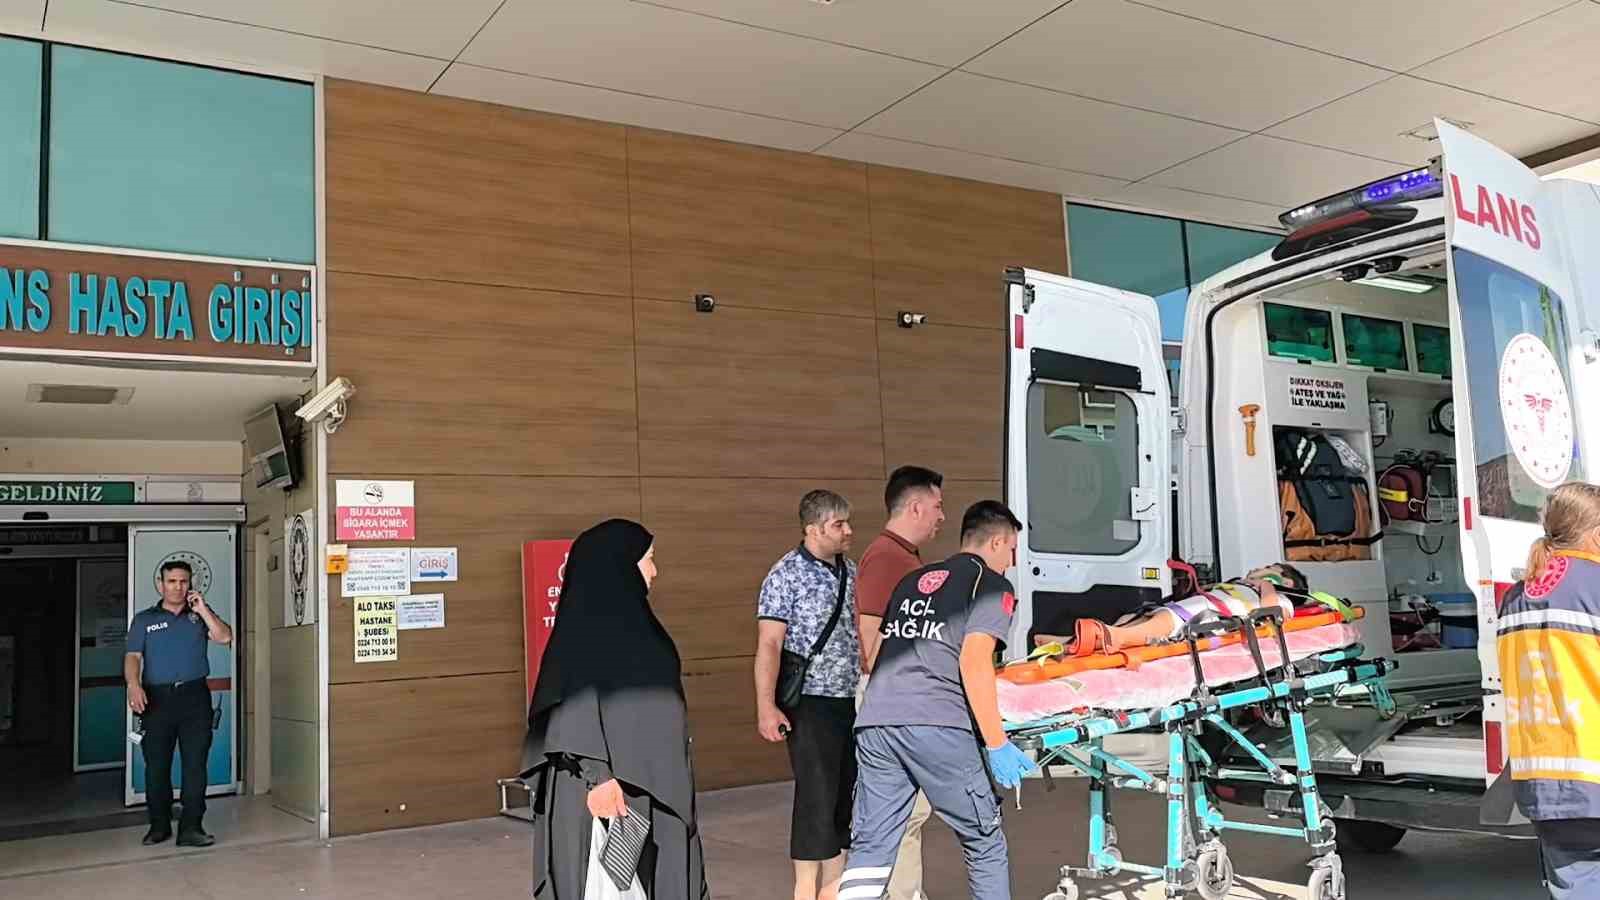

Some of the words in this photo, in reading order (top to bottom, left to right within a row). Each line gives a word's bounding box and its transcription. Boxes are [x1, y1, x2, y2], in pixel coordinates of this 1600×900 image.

[1449, 172, 1541, 250] LANS
[0, 267, 50, 332] NS
[68, 272, 194, 341] HASTA
[209, 271, 311, 355] GİRİŞİ
[1295, 388, 1314, 399] ATEŞ
[1315, 390, 1326, 399] VE
[1291, 397, 1305, 407] İLE
[1306, 398, 1345, 410] YAKLAŞMA
[0, 482, 103, 502] GELDİNİZ
[350, 507, 363, 516] BU
[364, 508, 402, 517] ALANDA
[343, 516, 378, 528] SİGARA
[379, 517, 409, 529] İÇMEK
[353, 528, 399, 540] YASAKTIR
[357, 602, 373, 612] ALO
[374, 601, 396, 611] TAKSİ
[359, 616, 393, 626] HASTANE
[363, 628, 389, 638] ŞUBESİ
